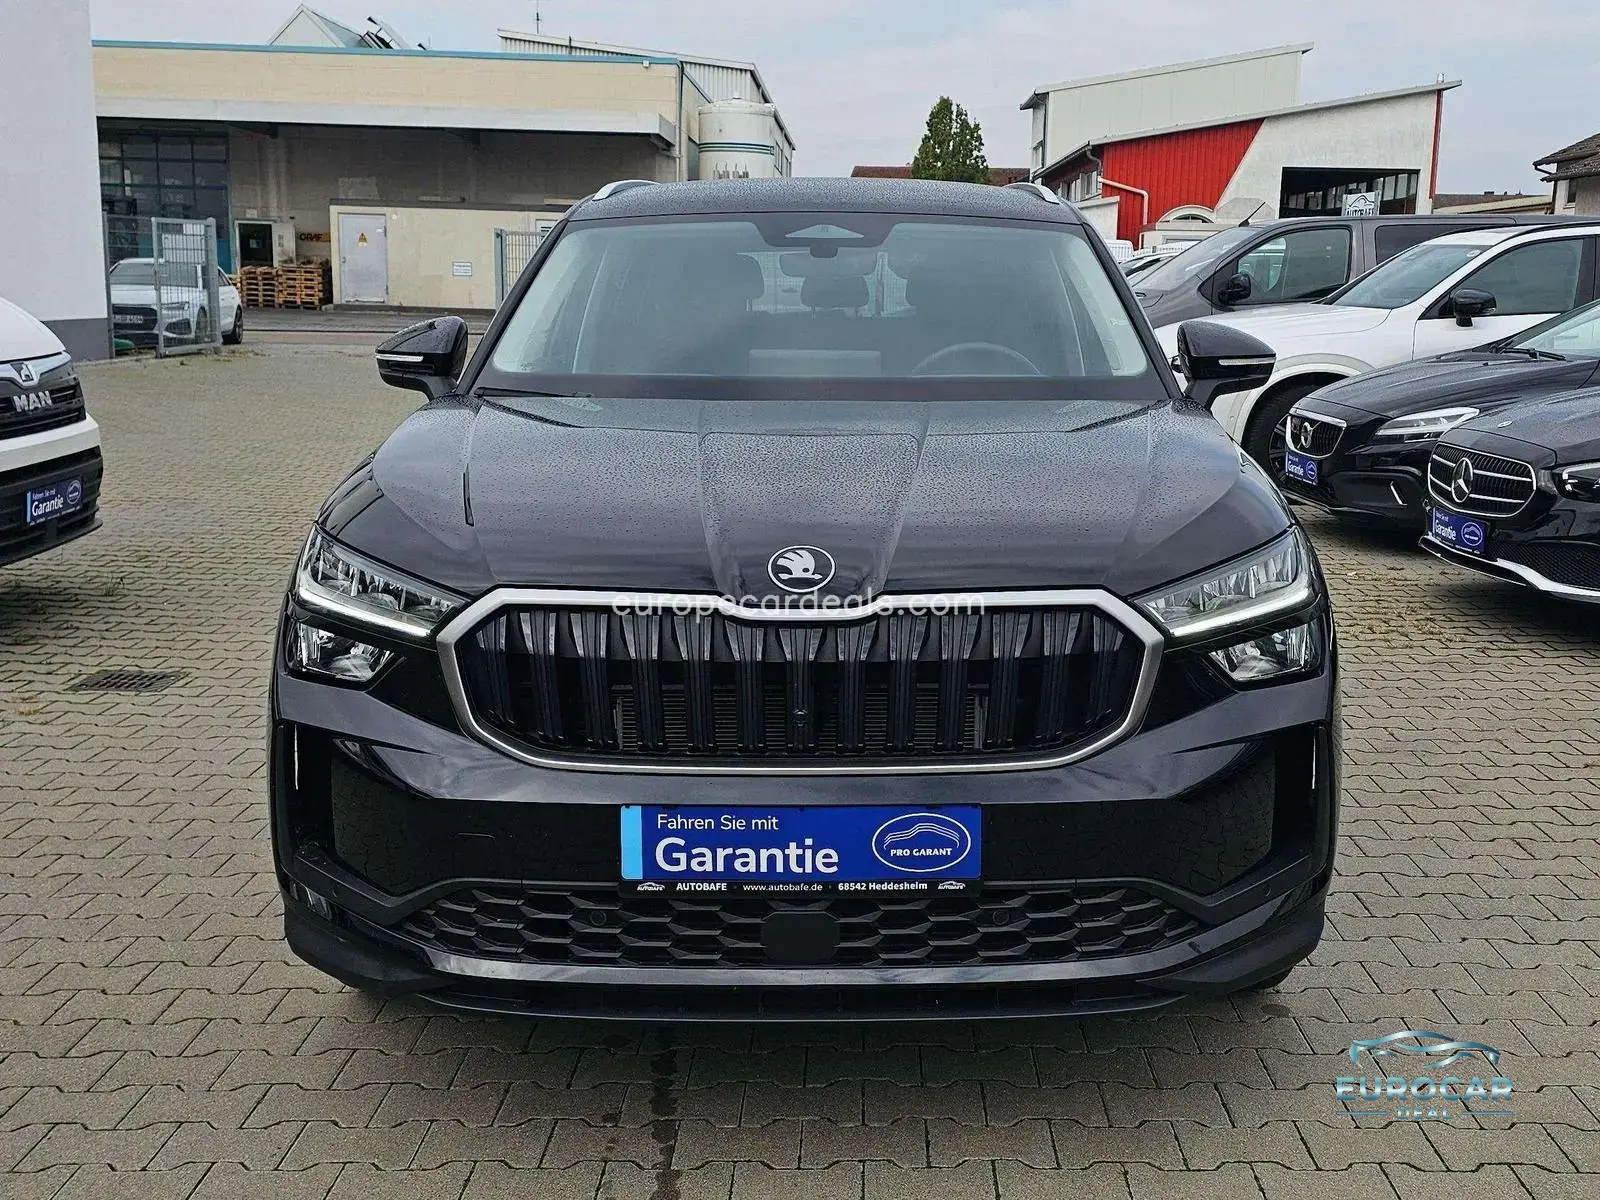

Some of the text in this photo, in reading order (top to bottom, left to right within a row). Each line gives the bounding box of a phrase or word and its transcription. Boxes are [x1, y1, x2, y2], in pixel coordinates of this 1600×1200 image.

[13, 390, 52, 412] MAN
[32, 494, 64, 516] Garantie
[657, 814, 779, 830] Fahren Sie mit
[655, 836, 839, 874] Garantie
[890, 847, 953, 857] PRO GARANT
[676, 881, 928, 891] AUTOBAFE www.autobafe.de 68542 Heddesheim
